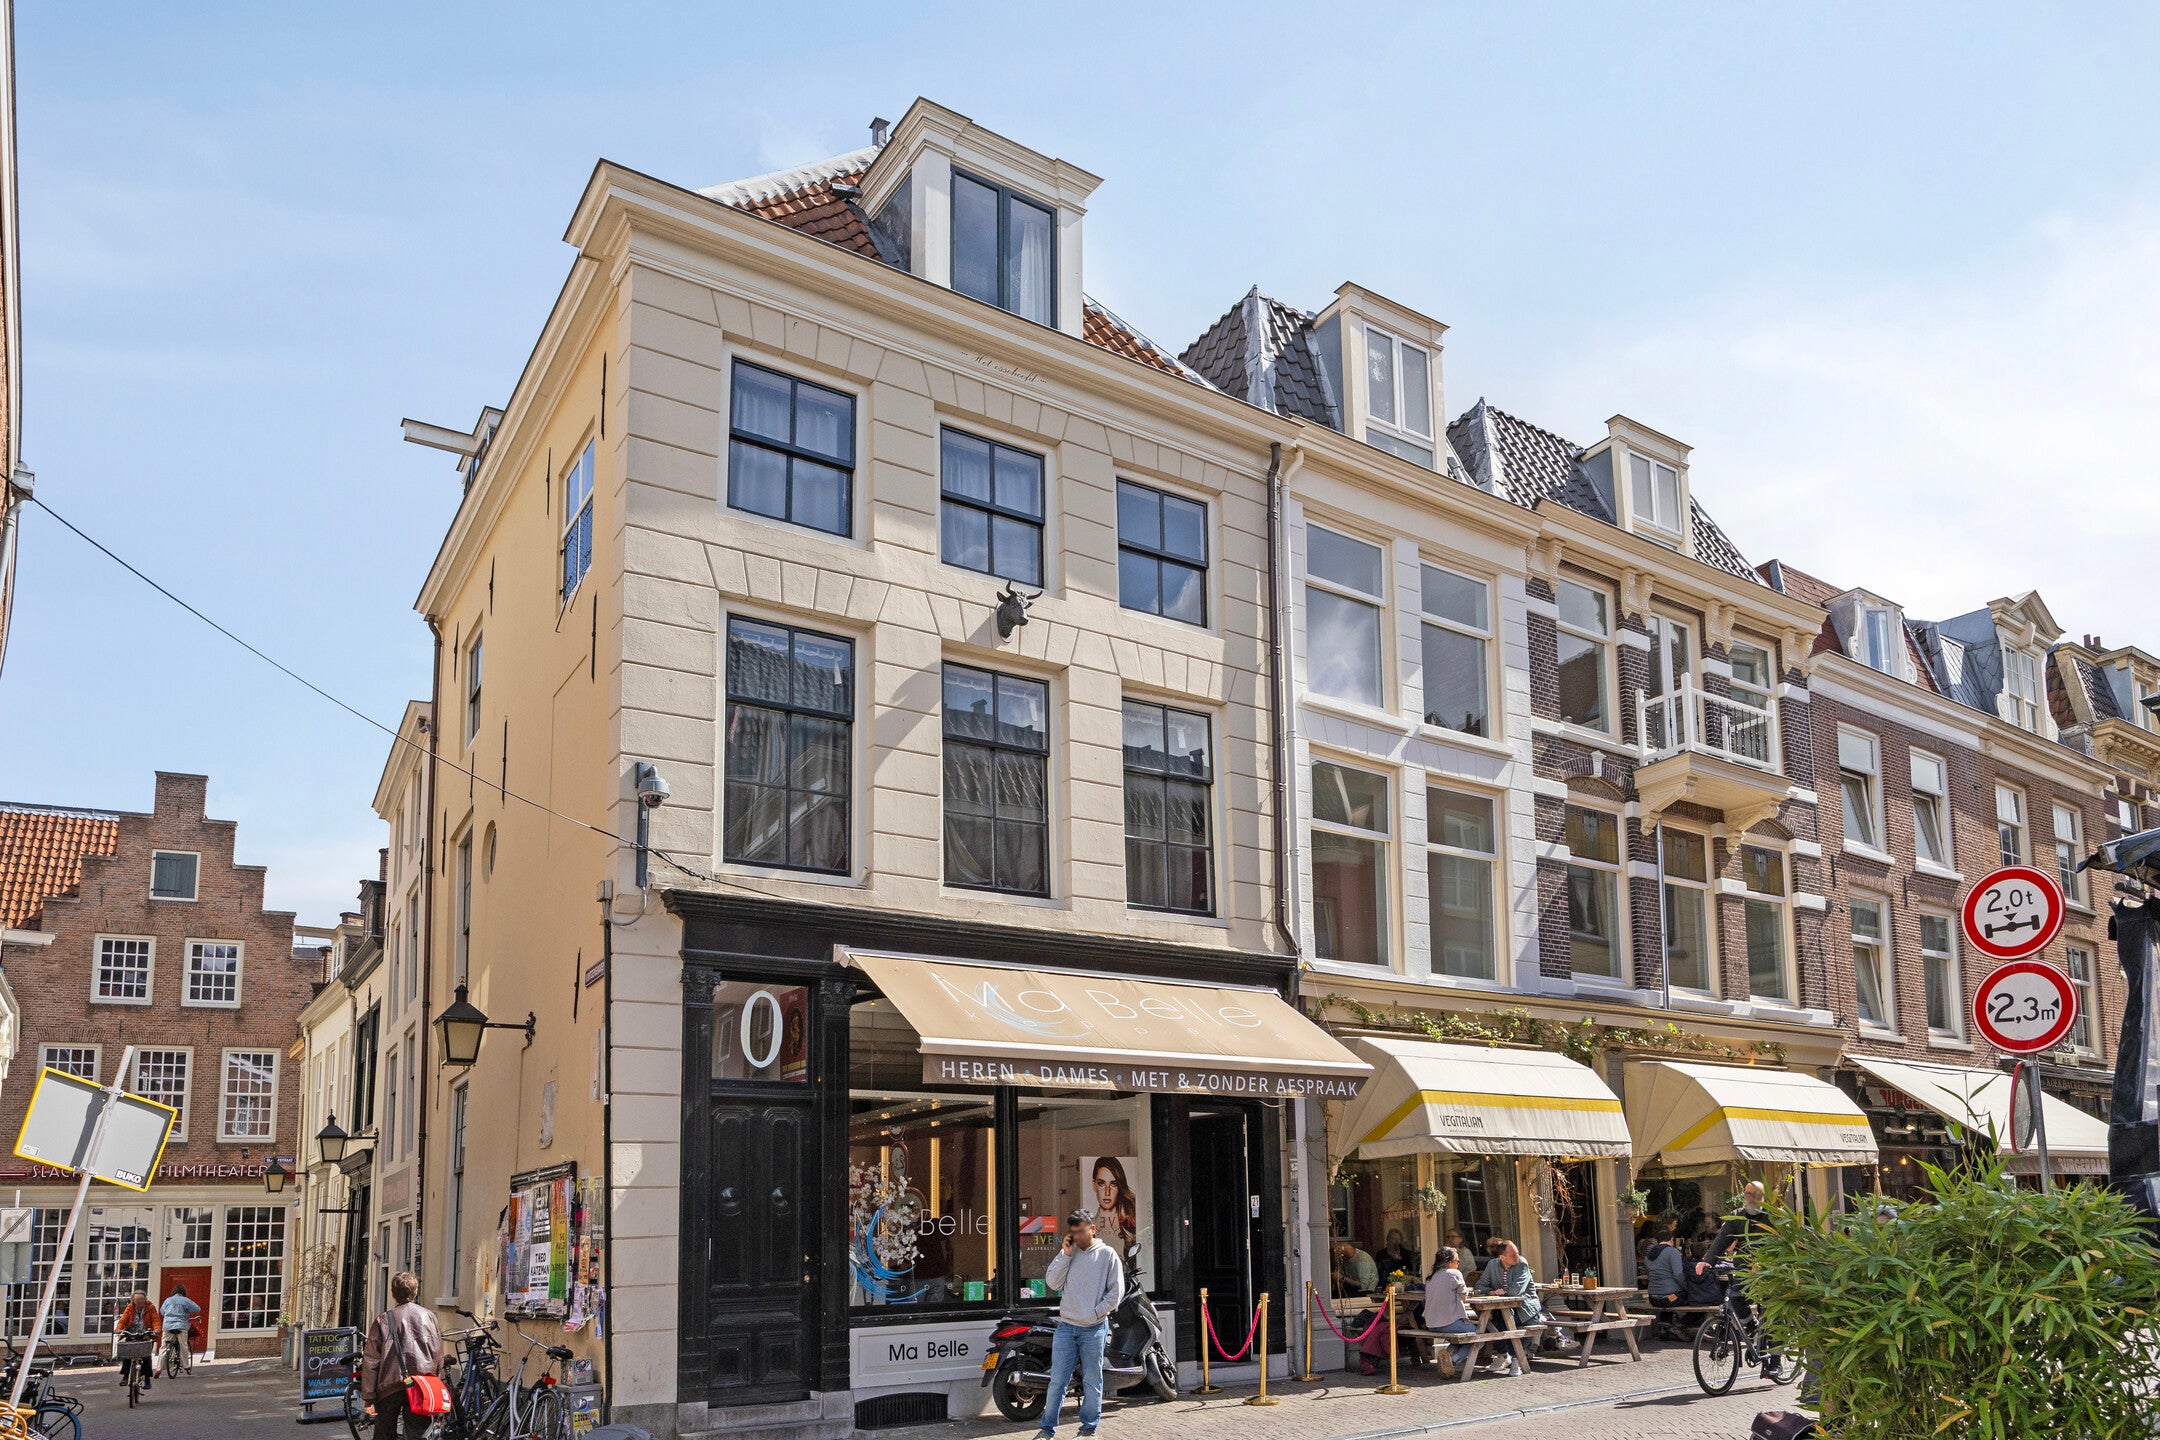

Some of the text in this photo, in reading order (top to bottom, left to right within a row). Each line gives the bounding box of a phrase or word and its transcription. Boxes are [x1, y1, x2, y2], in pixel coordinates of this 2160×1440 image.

[931, 972, 1262, 1028] Ma Belle
[941, 1060, 1358, 1097] HEREN DAMES MET & ZONDER AFSPRAAK
[1440, 1115, 1484, 1128] VEGITALIAN
[116, 1169, 142, 1183] BUKO
[920, 1208, 993, 1236] Belle
[309, 1344, 349, 1354] PIERCING
[889, 1340, 969, 1361] Ma Belle
[308, 1377, 349, 1387] WALK INS
